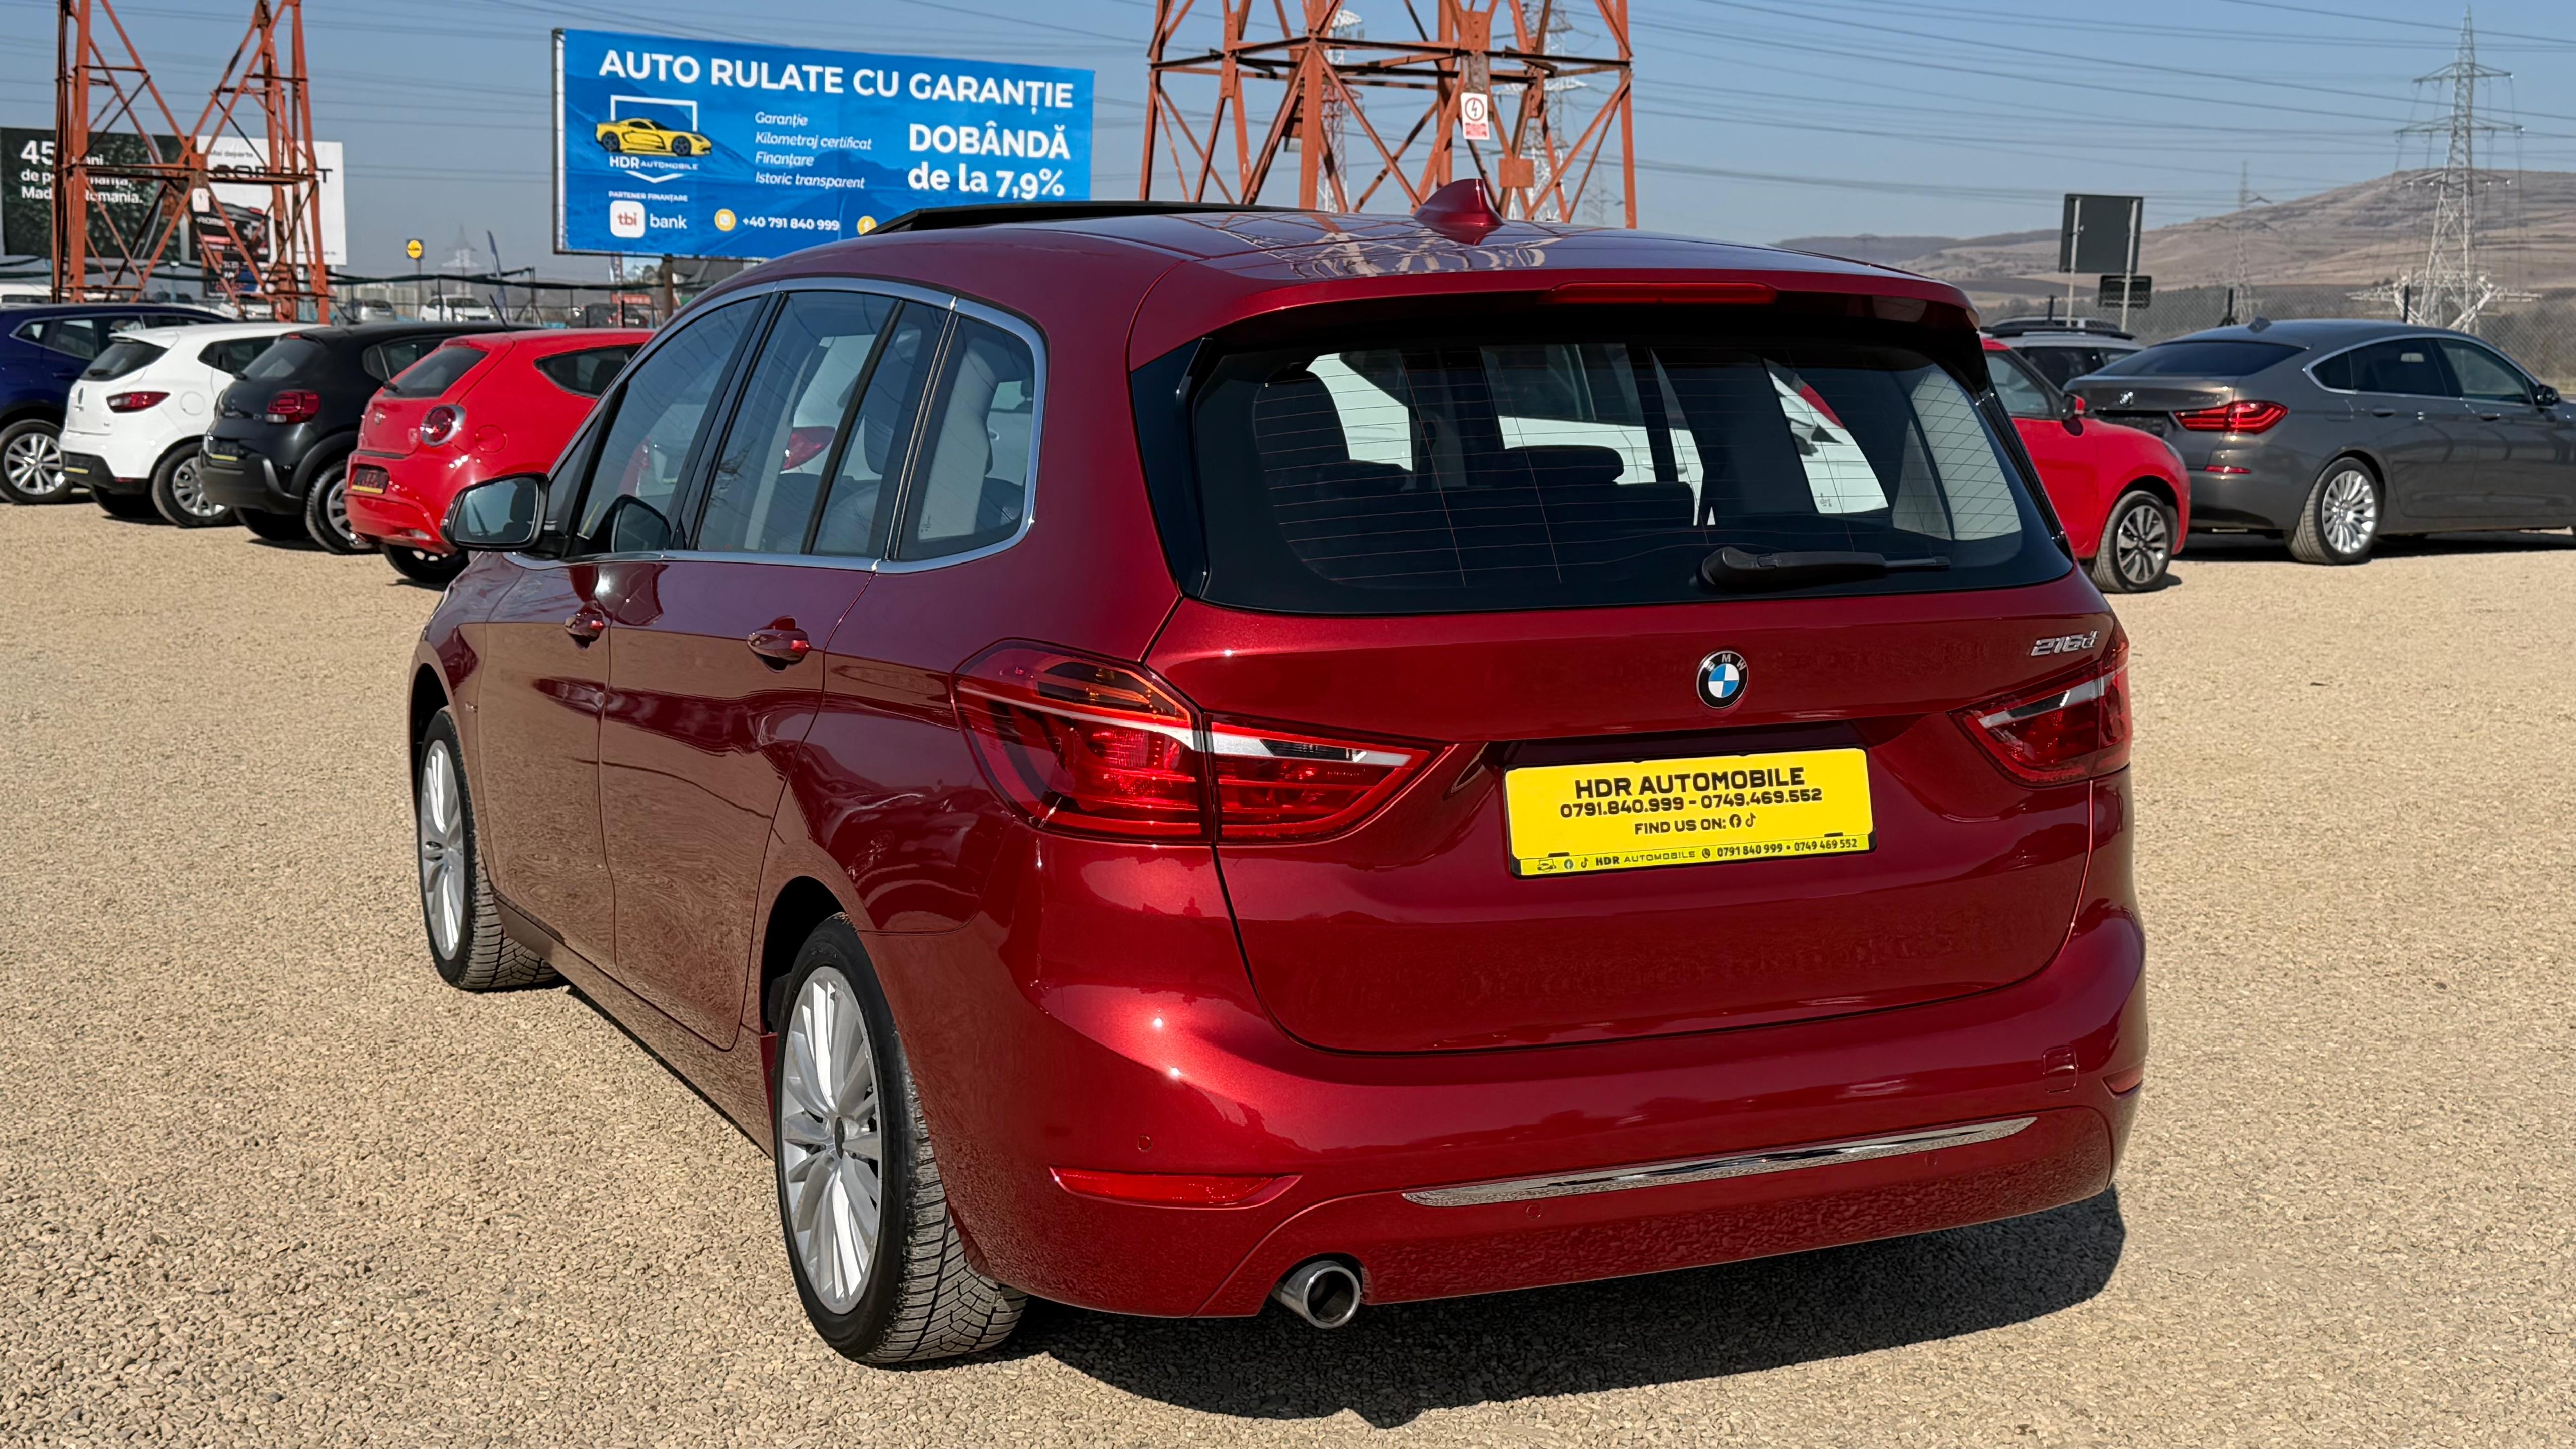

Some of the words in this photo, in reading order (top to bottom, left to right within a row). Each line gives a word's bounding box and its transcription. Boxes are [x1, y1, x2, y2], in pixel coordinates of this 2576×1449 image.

[599, 49, 700, 84] AUTO
[711, 58, 844, 94] RULATE
[853, 69, 899, 97] CU
[909, 73, 1074, 115] GARANȚIE
[755, 131, 819, 149] Kilometraj
[820, 137, 872, 150] certificat
[909, 120, 1071, 159] DOBÂNDĂ
[609, 155, 640, 169] HDR
[640, 160, 699, 170] AUTOMOBILE
[21, 168, 39, 182] de
[755, 171, 793, 185] Istoric
[795, 174, 865, 190] transparent
[908, 161, 950, 191] de
[959, 163, 988, 193] la
[995, 168, 1065, 201] 7,9%
[617, 213, 637, 226] tbi
[650, 213, 688, 229] bank
[743, 216, 766, 228] +40
[768, 217, 787, 229] 791
[790, 218, 815, 230] 840
[817, 219, 840, 231] 999
[2031, 630, 2098, 656] 216d
[1575, 777, 1633, 799] HDR
[1638, 767, 1805, 795] AUTOMOBILE
[1560, 797, 1684, 818] 0791.840.999
[1701, 788, 1822, 809] 0749.469.552
[1635, 821, 1670, 835] FIND
[1674, 819, 1697, 833] US
[1700, 818, 1726, 831] ON:
[1595, 856, 1620, 867] HDR
[1624, 851, 1696, 863] AUTOMOBILE
[1717, 845, 1741, 857] 0791
[1742, 844, 1761, 855] 840
[1764, 843, 1783, 854] 999
[1794, 840, 1817, 852] 0749
[1819, 839, 1838, 850] 469
[1840, 838, 1858, 849] 552
